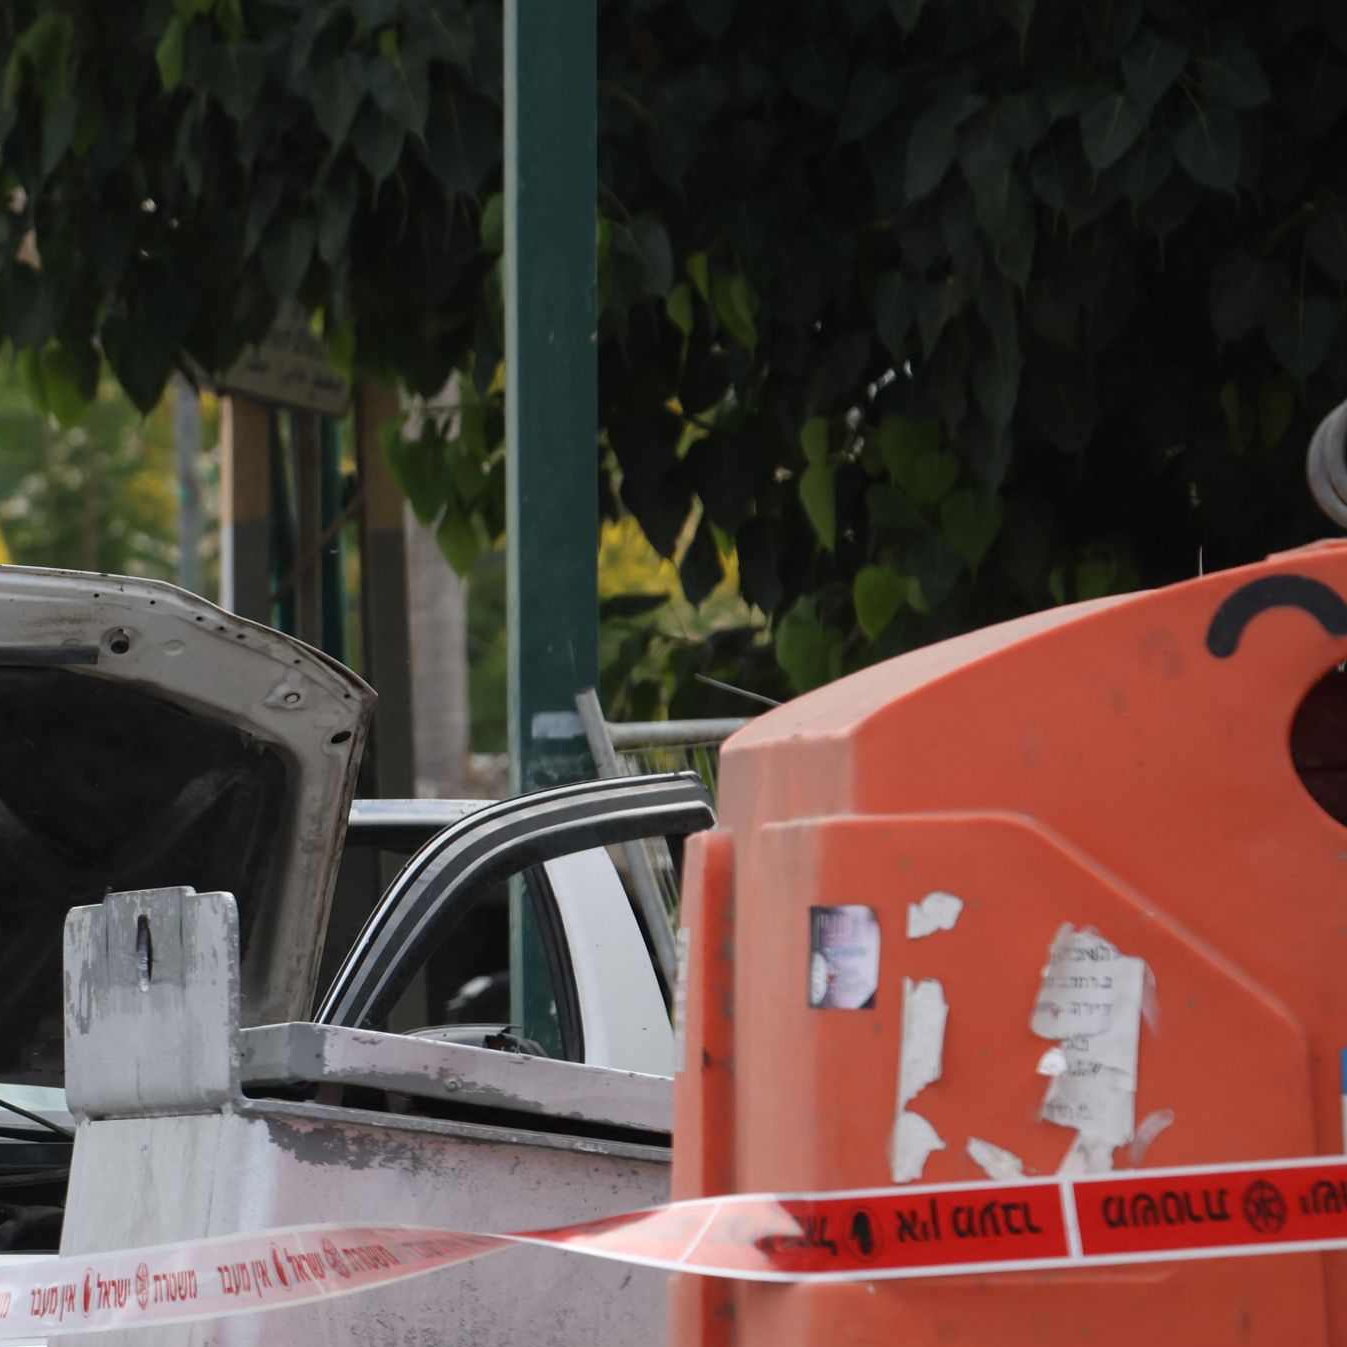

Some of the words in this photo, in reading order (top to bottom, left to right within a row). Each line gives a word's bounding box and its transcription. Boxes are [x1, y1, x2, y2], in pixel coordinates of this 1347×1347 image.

[896, 1199, 941, 1243] אין
[951, 1200, 1043, 1238] מעבר
[1103, 1188, 1233, 1229] משטרת
[218, 1262, 251, 1295] מעבר
[252, 1258, 273, 1298] אין
[283, 1247, 326, 1283] ישראל
[30, 1286, 58, 1318] מעבר
[59, 1284, 77, 1322] אין
[97, 1272, 131, 1310] ישראל
[153, 1270, 198, 1303] משטרת
